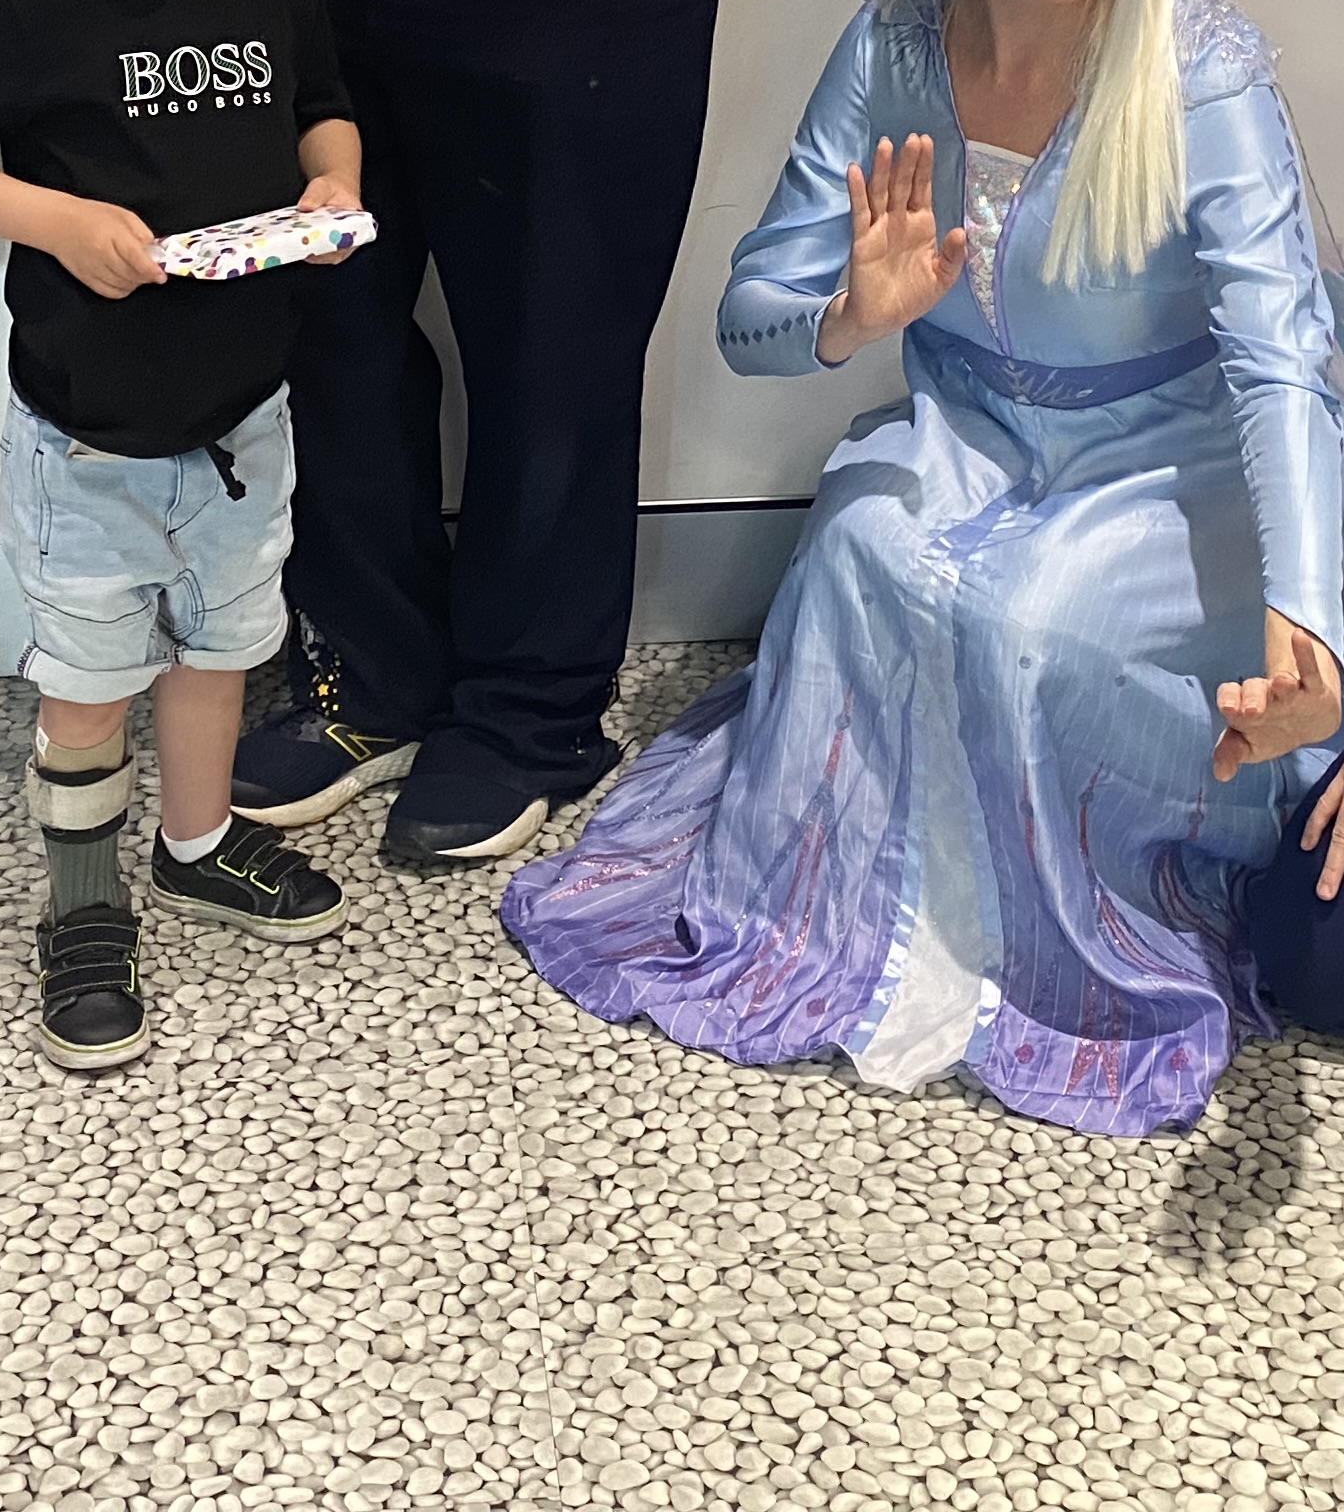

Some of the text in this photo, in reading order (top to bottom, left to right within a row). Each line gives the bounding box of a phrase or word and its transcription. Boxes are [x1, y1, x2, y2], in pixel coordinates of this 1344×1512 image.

[118, 40, 273, 102] BOSS
[127, 92, 272, 118] HUGO BOSS
